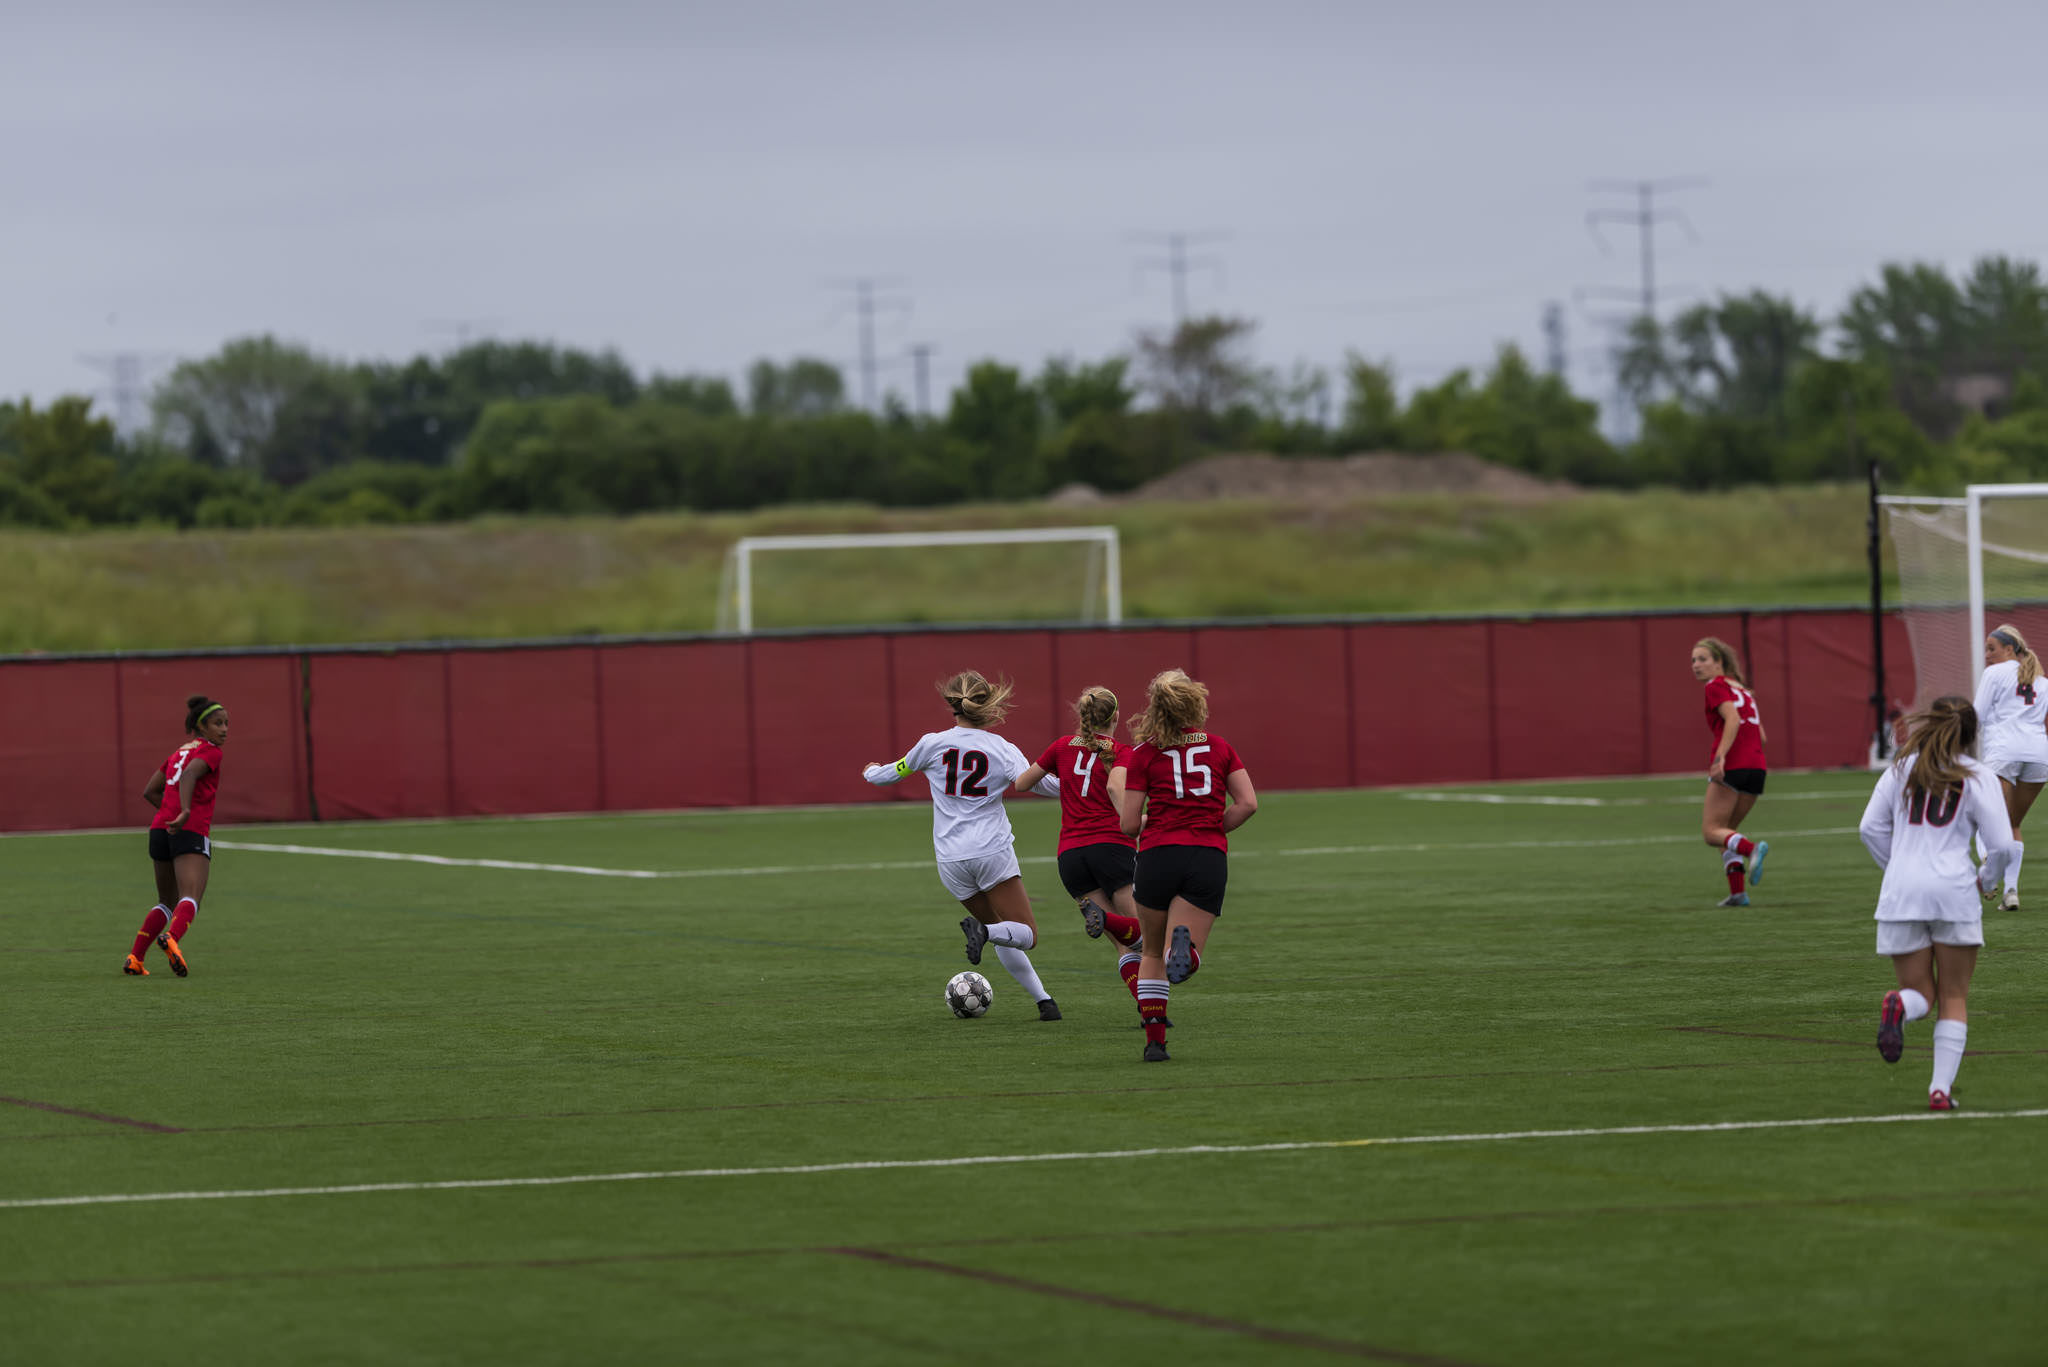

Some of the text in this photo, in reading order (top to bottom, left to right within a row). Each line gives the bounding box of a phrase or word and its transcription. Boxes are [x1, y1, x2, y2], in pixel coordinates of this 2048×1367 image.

[2016, 683, 2037, 705] 4
[166, 750, 190, 785] 3
[943, 748, 989, 797] 12
[1073, 750, 1098, 797] 4
[1162, 745, 1210, 799] 15
